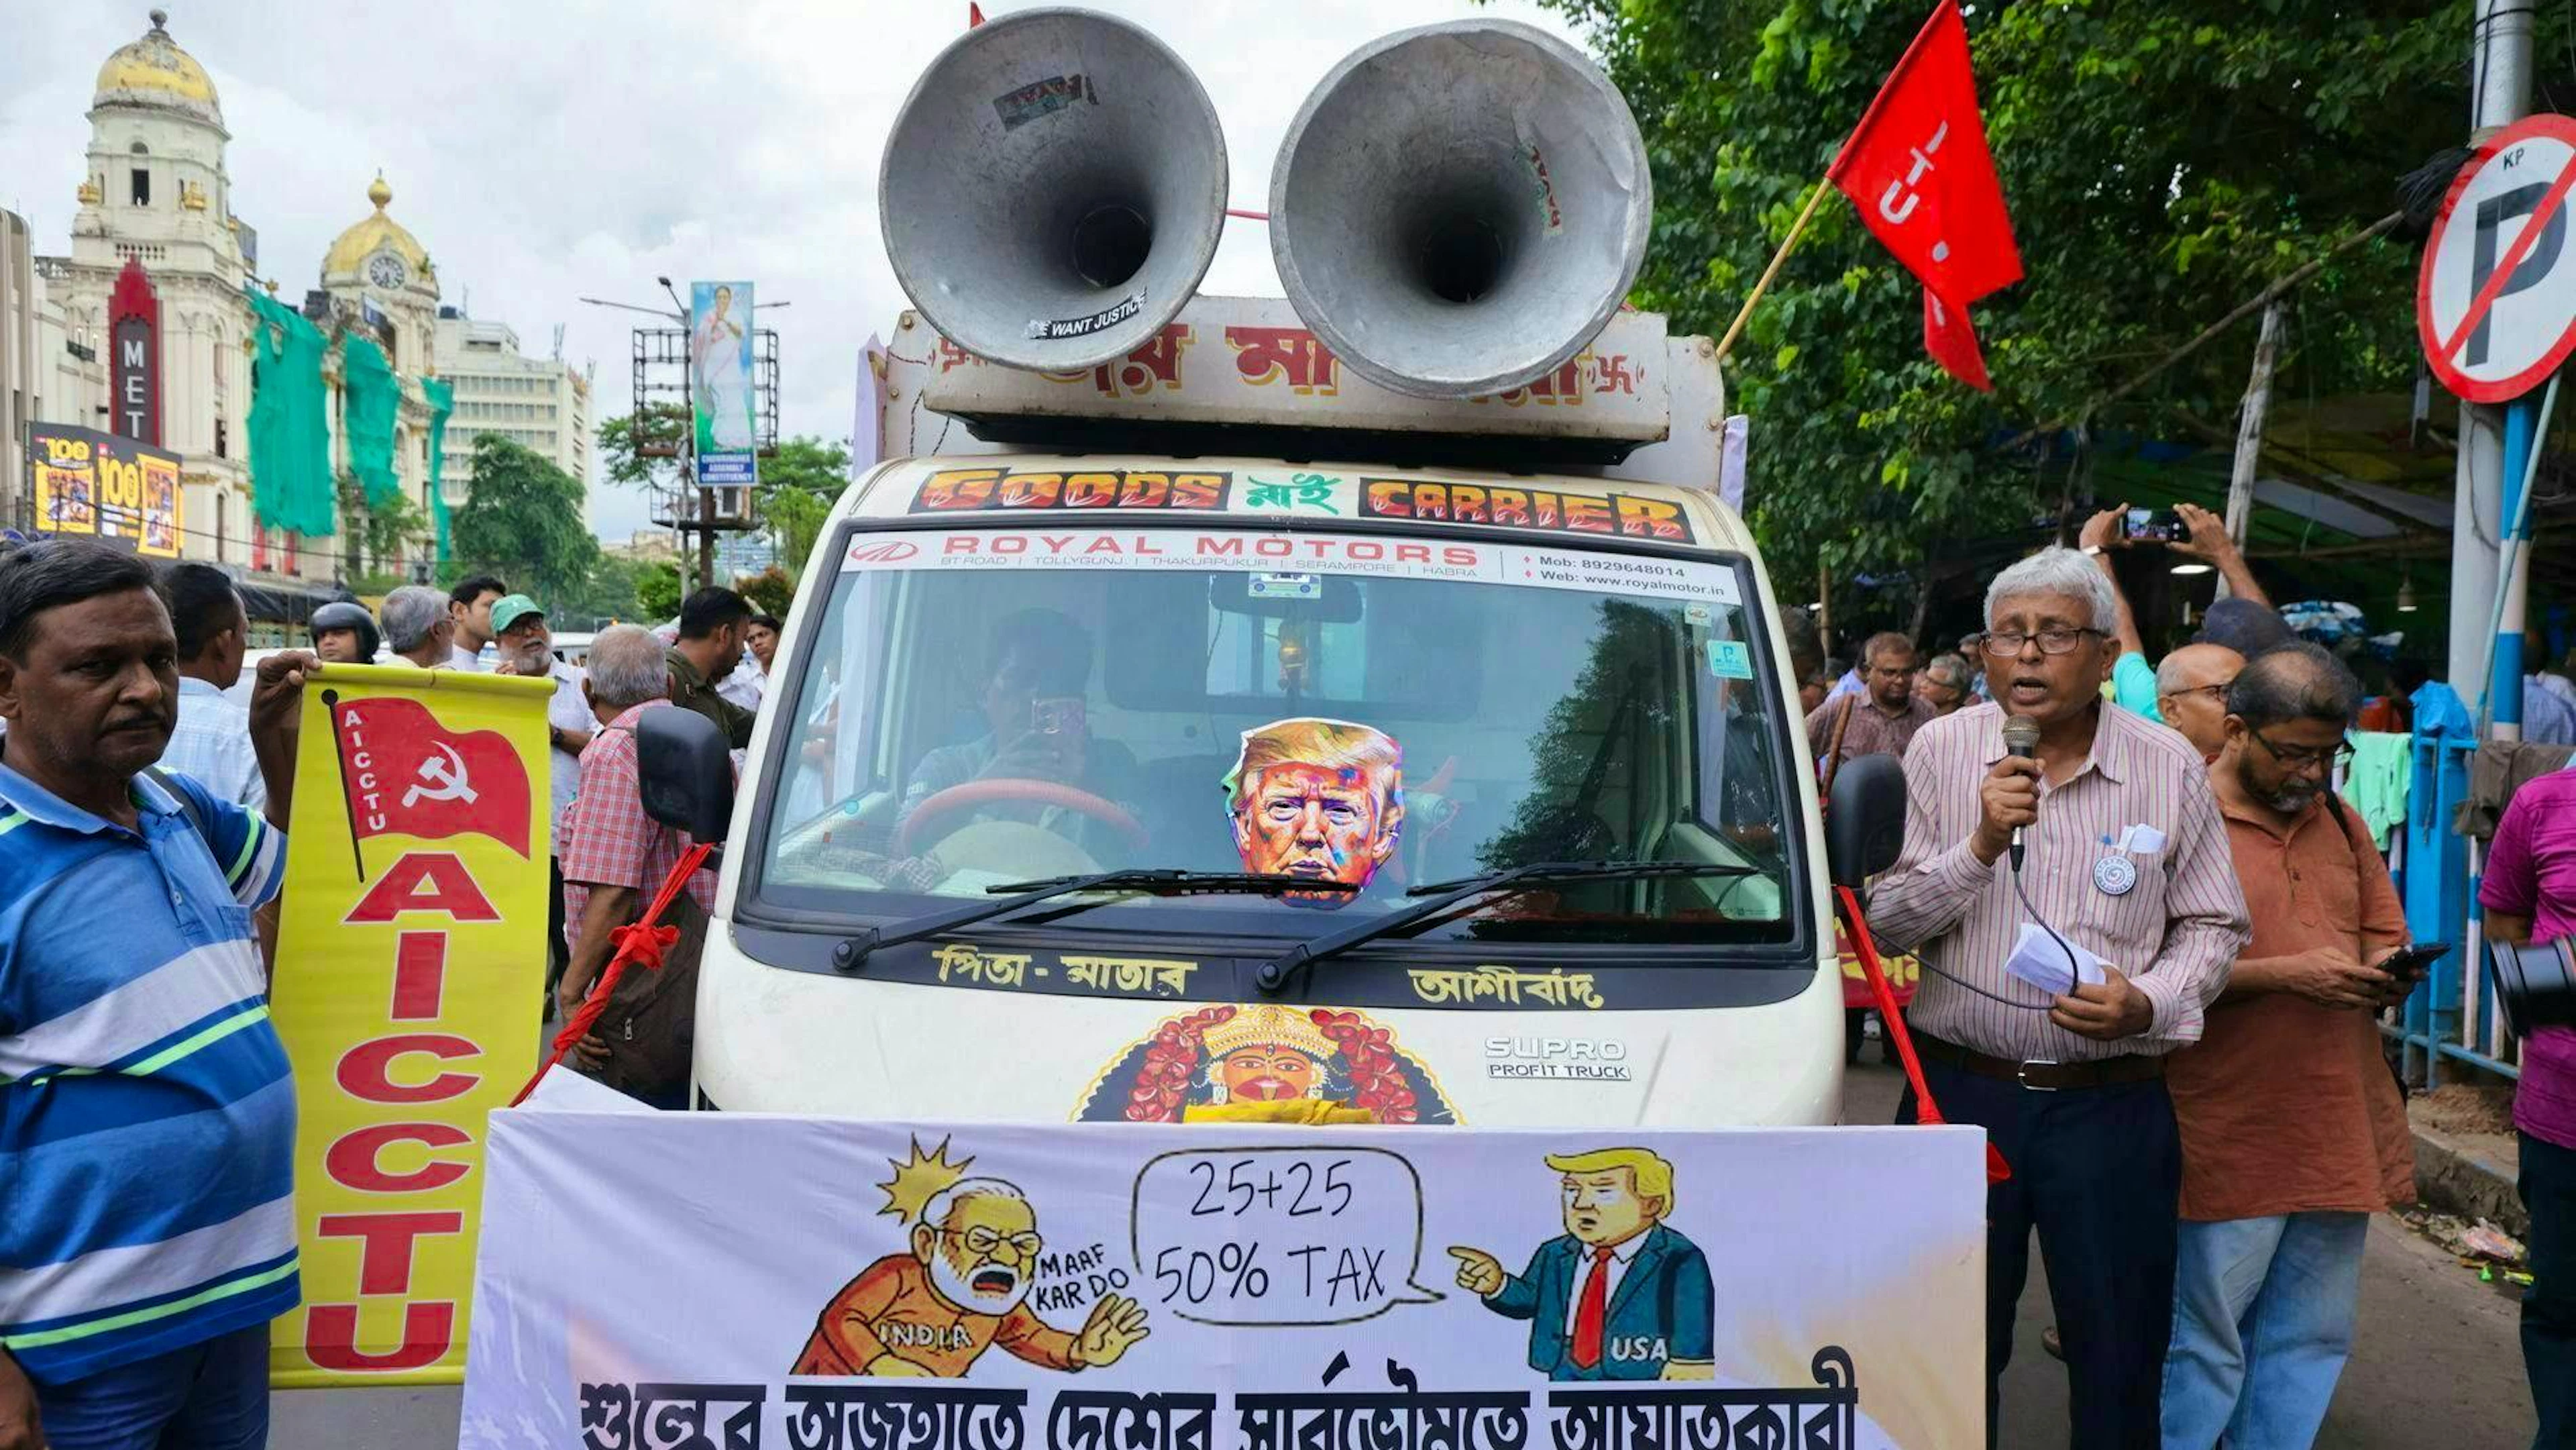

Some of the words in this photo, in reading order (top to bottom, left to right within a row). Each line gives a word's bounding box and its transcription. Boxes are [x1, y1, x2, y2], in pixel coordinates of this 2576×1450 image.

[2503, 147, 2525, 170] KP
[2465, 181, 2567, 368] P
[1052, 317, 1093, 336] WANT
[1093, 295, 1146, 329] JUSTICE
[46, 438, 91, 461] 100
[98, 456, 140, 508] 100
[920, 469, 1222, 509] GOODS
[1368, 482, 1685, 539] CARRIER
[944, 536, 1162, 554] ROYAL
[1197, 537, 1478, 566] MOTORS
[1150, 557, 1269, 567] THAKURPUKUR
[1295, 560, 1395, 572] SERAMPORE
[1423, 566, 1478, 577] HABRA
[1540, 556, 1576, 568] Mob:
[1582, 559, 1685, 578] 8929648014
[1542, 570, 1578, 582] Web:
[1584, 574, 1725, 597] www.royalmotor.in
[344, 710, 387, 831] AICCTU
[932, 944, 1032, 987] পিতা
[1060, 955, 1198, 996] মাতার
[1485, 1037, 1627, 1061] SUPRO
[1489, 1064, 1558, 1078] PROFIT
[1563, 1066, 1626, 1079] TRUCK
[305, 851, 504, 1374] AICCTU
[1189, 1159, 1352, 1216] 25+25
[1040, 1244, 1106, 1279] MAAF
[1155, 1241, 1270, 1304] 50%
[1287, 1245, 1385, 1307] TAX
[877, 1323, 974, 1348] INDIA
[1611, 1337, 1669, 1361] USA
